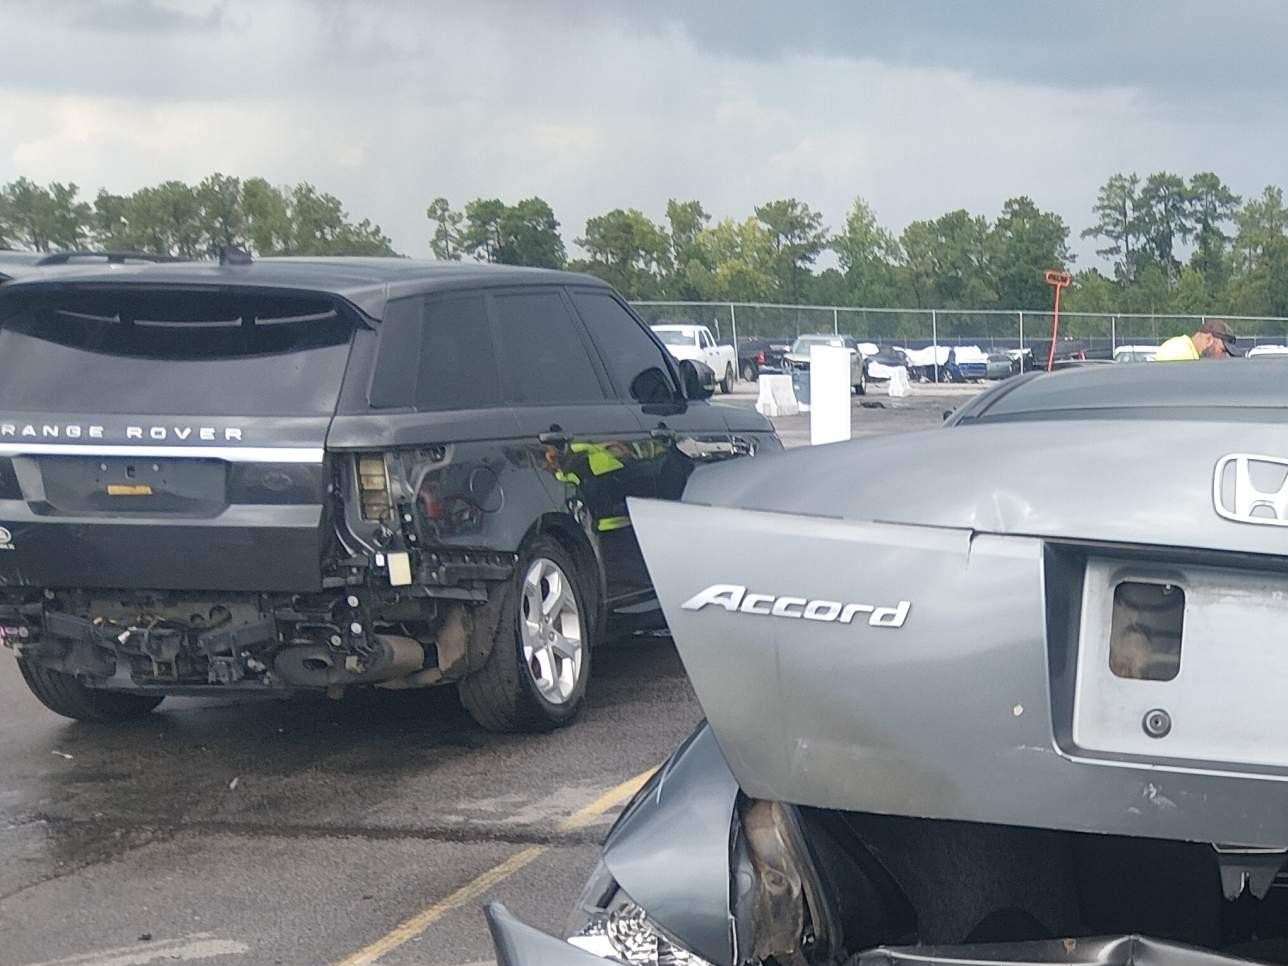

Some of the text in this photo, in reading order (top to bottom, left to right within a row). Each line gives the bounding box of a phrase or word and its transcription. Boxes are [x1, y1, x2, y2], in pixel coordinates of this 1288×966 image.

[0, 424, 242, 440] RANGE ROVER
[681, 583, 911, 628] Accord
